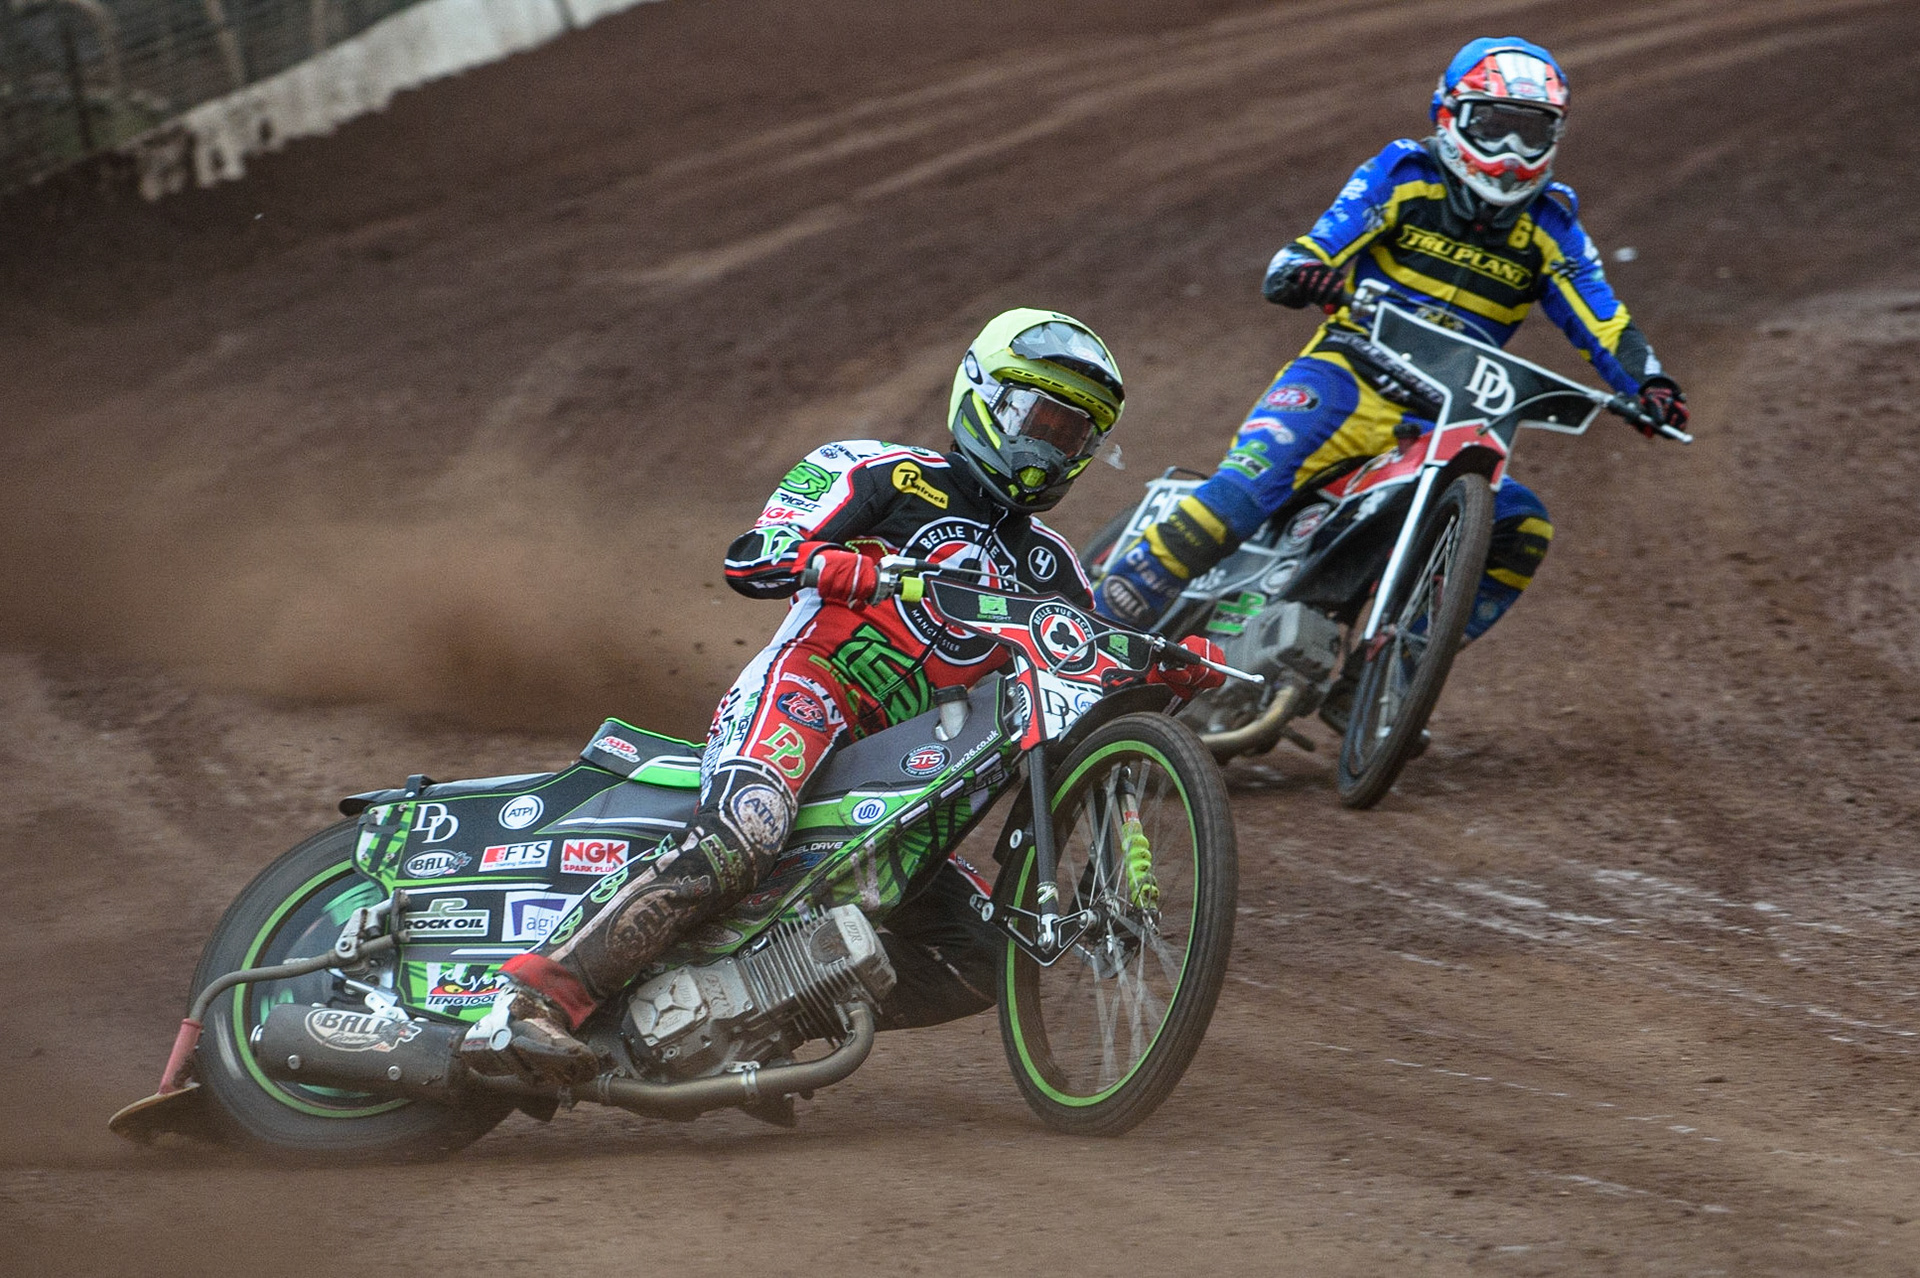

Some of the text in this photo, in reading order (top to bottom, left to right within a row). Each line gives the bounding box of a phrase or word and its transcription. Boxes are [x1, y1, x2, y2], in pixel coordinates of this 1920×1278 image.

[1507, 218, 1534, 249] 6
[1453, 247, 1525, 284] PLANT
[919, 525, 966, 550] BELLE
[1034, 549, 1051, 576] 4
[1033, 606, 1053, 626] BELLE
[1054, 606, 1073, 617] VUE
[909, 754, 942, 766] STS
[950, 730, 999, 773] cwr26.co.uk
[507, 806, 533, 819] ATPI
[744, 797, 779, 836] ATPI
[504, 842, 548, 861] FTS
[563, 841, 627, 865] NGK
[810, 841, 844, 851] DAVE
[563, 864, 593, 873] SPARK
[453, 918, 485, 930] OIL
